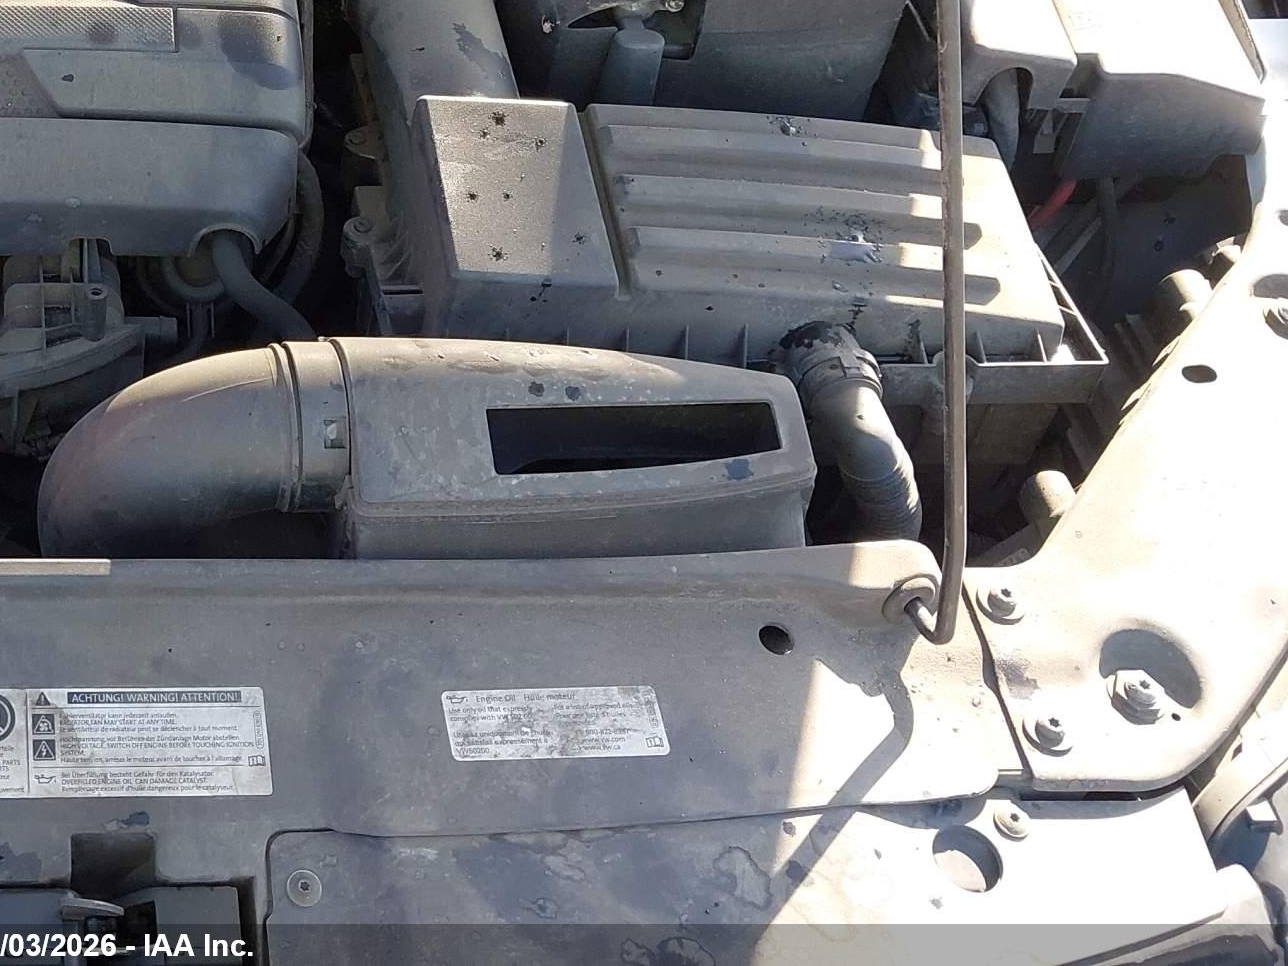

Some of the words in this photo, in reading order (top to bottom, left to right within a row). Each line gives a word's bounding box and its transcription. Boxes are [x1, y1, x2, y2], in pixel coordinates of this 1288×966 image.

[72, 693, 124, 702] ACHTUNG!
[126, 693, 178, 702] WARNING!
[181, 692, 238, 701] ATTENTION!
[476, 696, 504, 704] Engine
